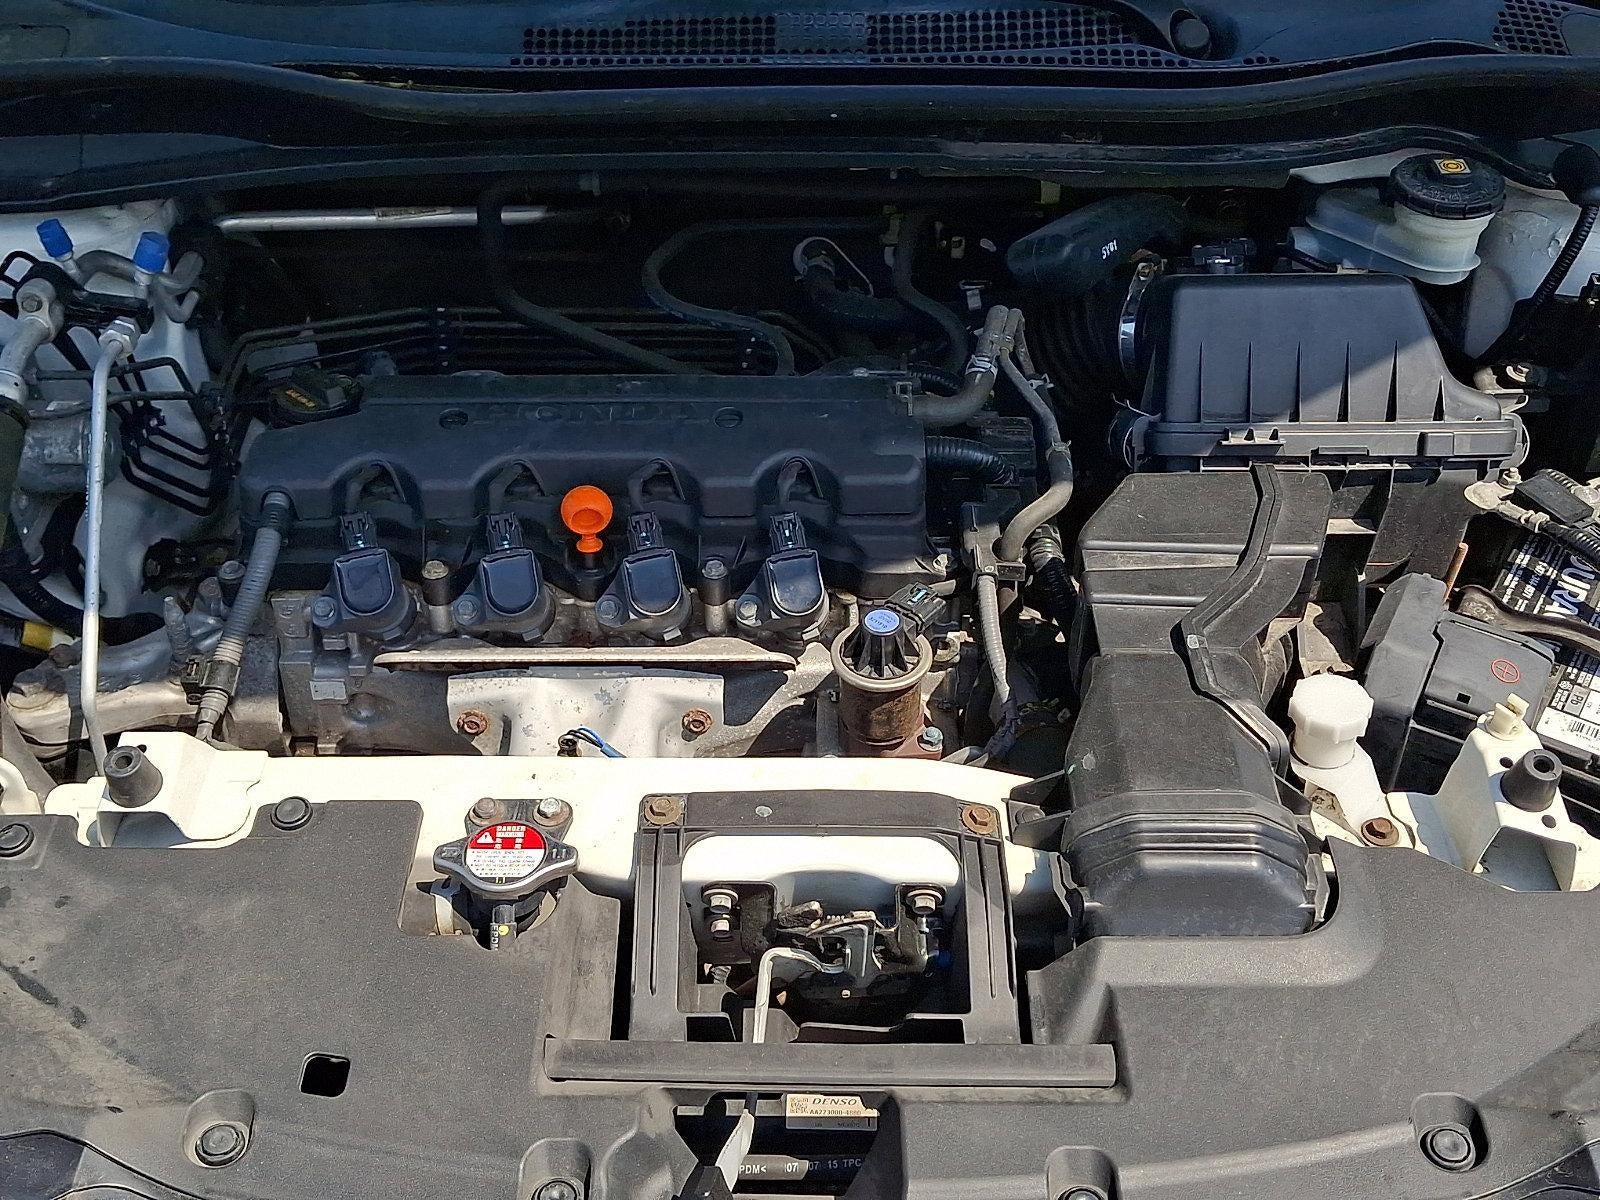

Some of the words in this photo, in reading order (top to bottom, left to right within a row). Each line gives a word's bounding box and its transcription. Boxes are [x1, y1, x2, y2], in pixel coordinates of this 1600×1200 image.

[1570, 693, 1584, 706] Pb
[812, 1098, 857, 1106] DENSO
[842, 1158, 862, 1168] TPC
